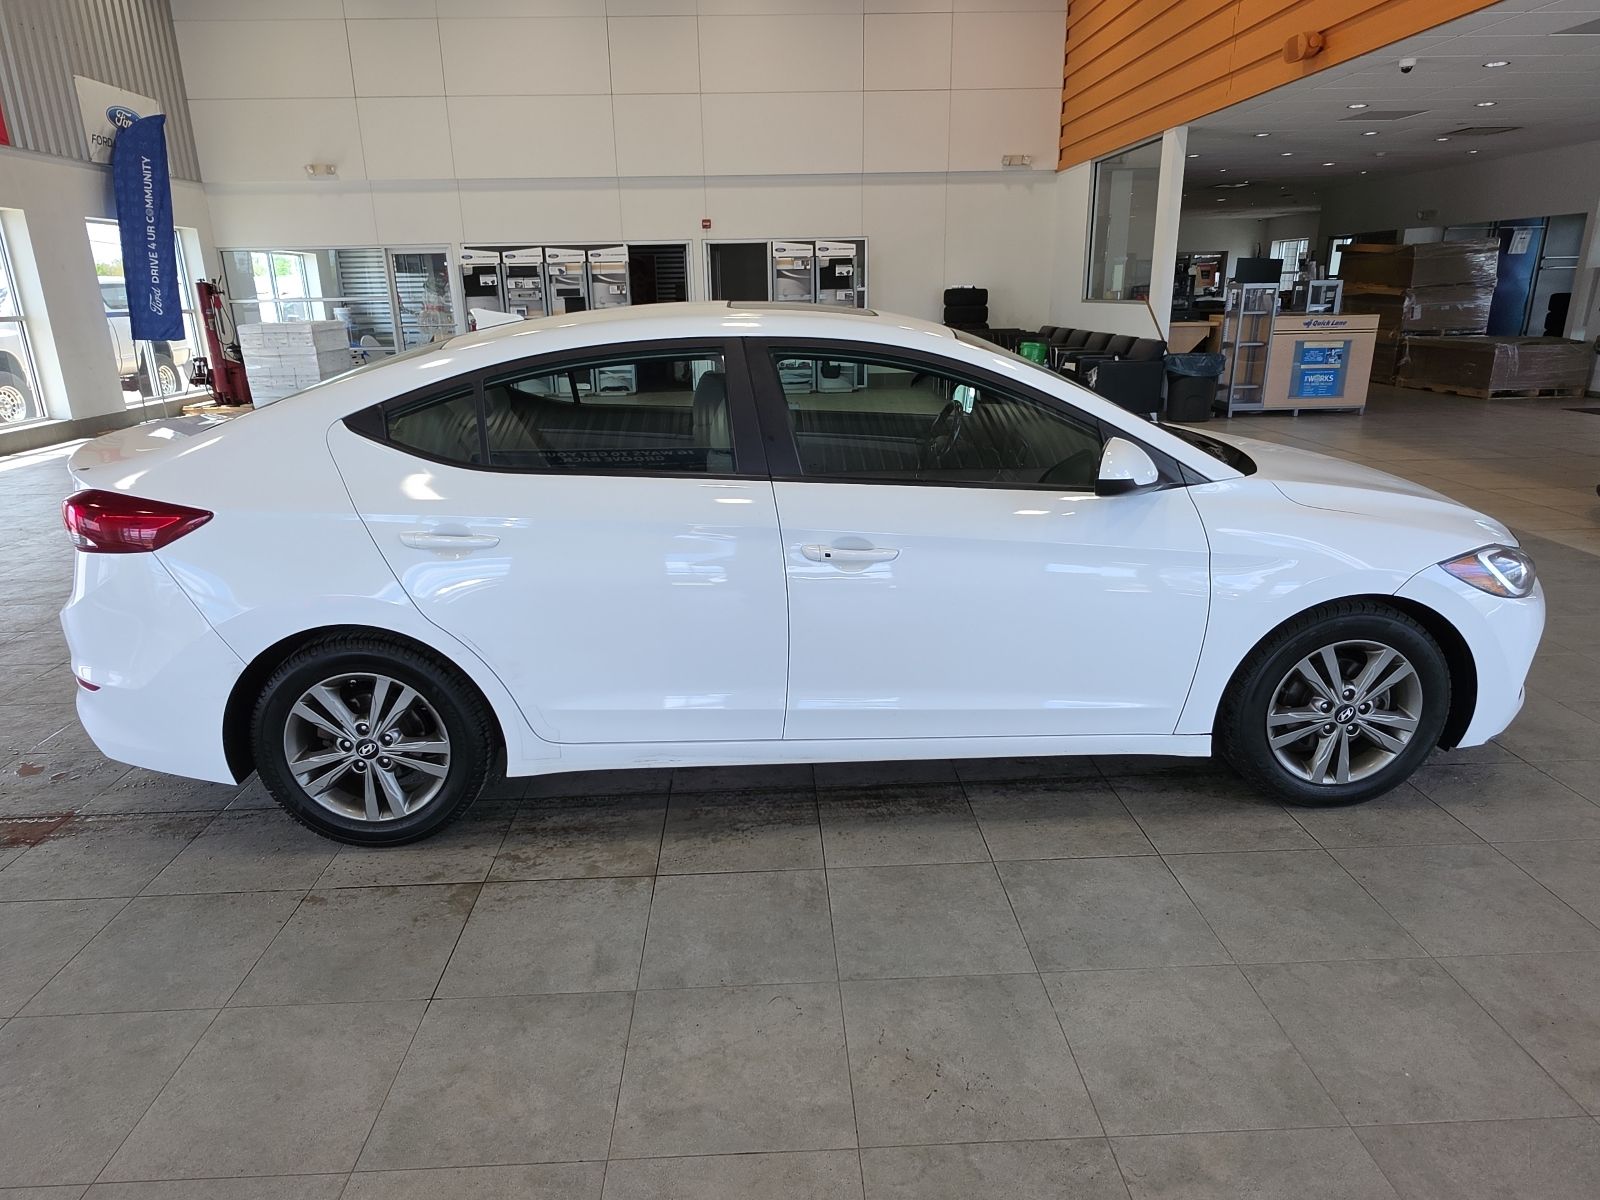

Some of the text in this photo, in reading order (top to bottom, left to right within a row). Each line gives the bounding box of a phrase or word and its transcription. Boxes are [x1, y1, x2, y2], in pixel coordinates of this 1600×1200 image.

[115, 109, 133, 128] For
[91, 134, 113, 147] FORD
[141, 155, 163, 316] Ford DRIVE 4 UR COMMUNITY
[1312, 319, 1330, 327] Quick
